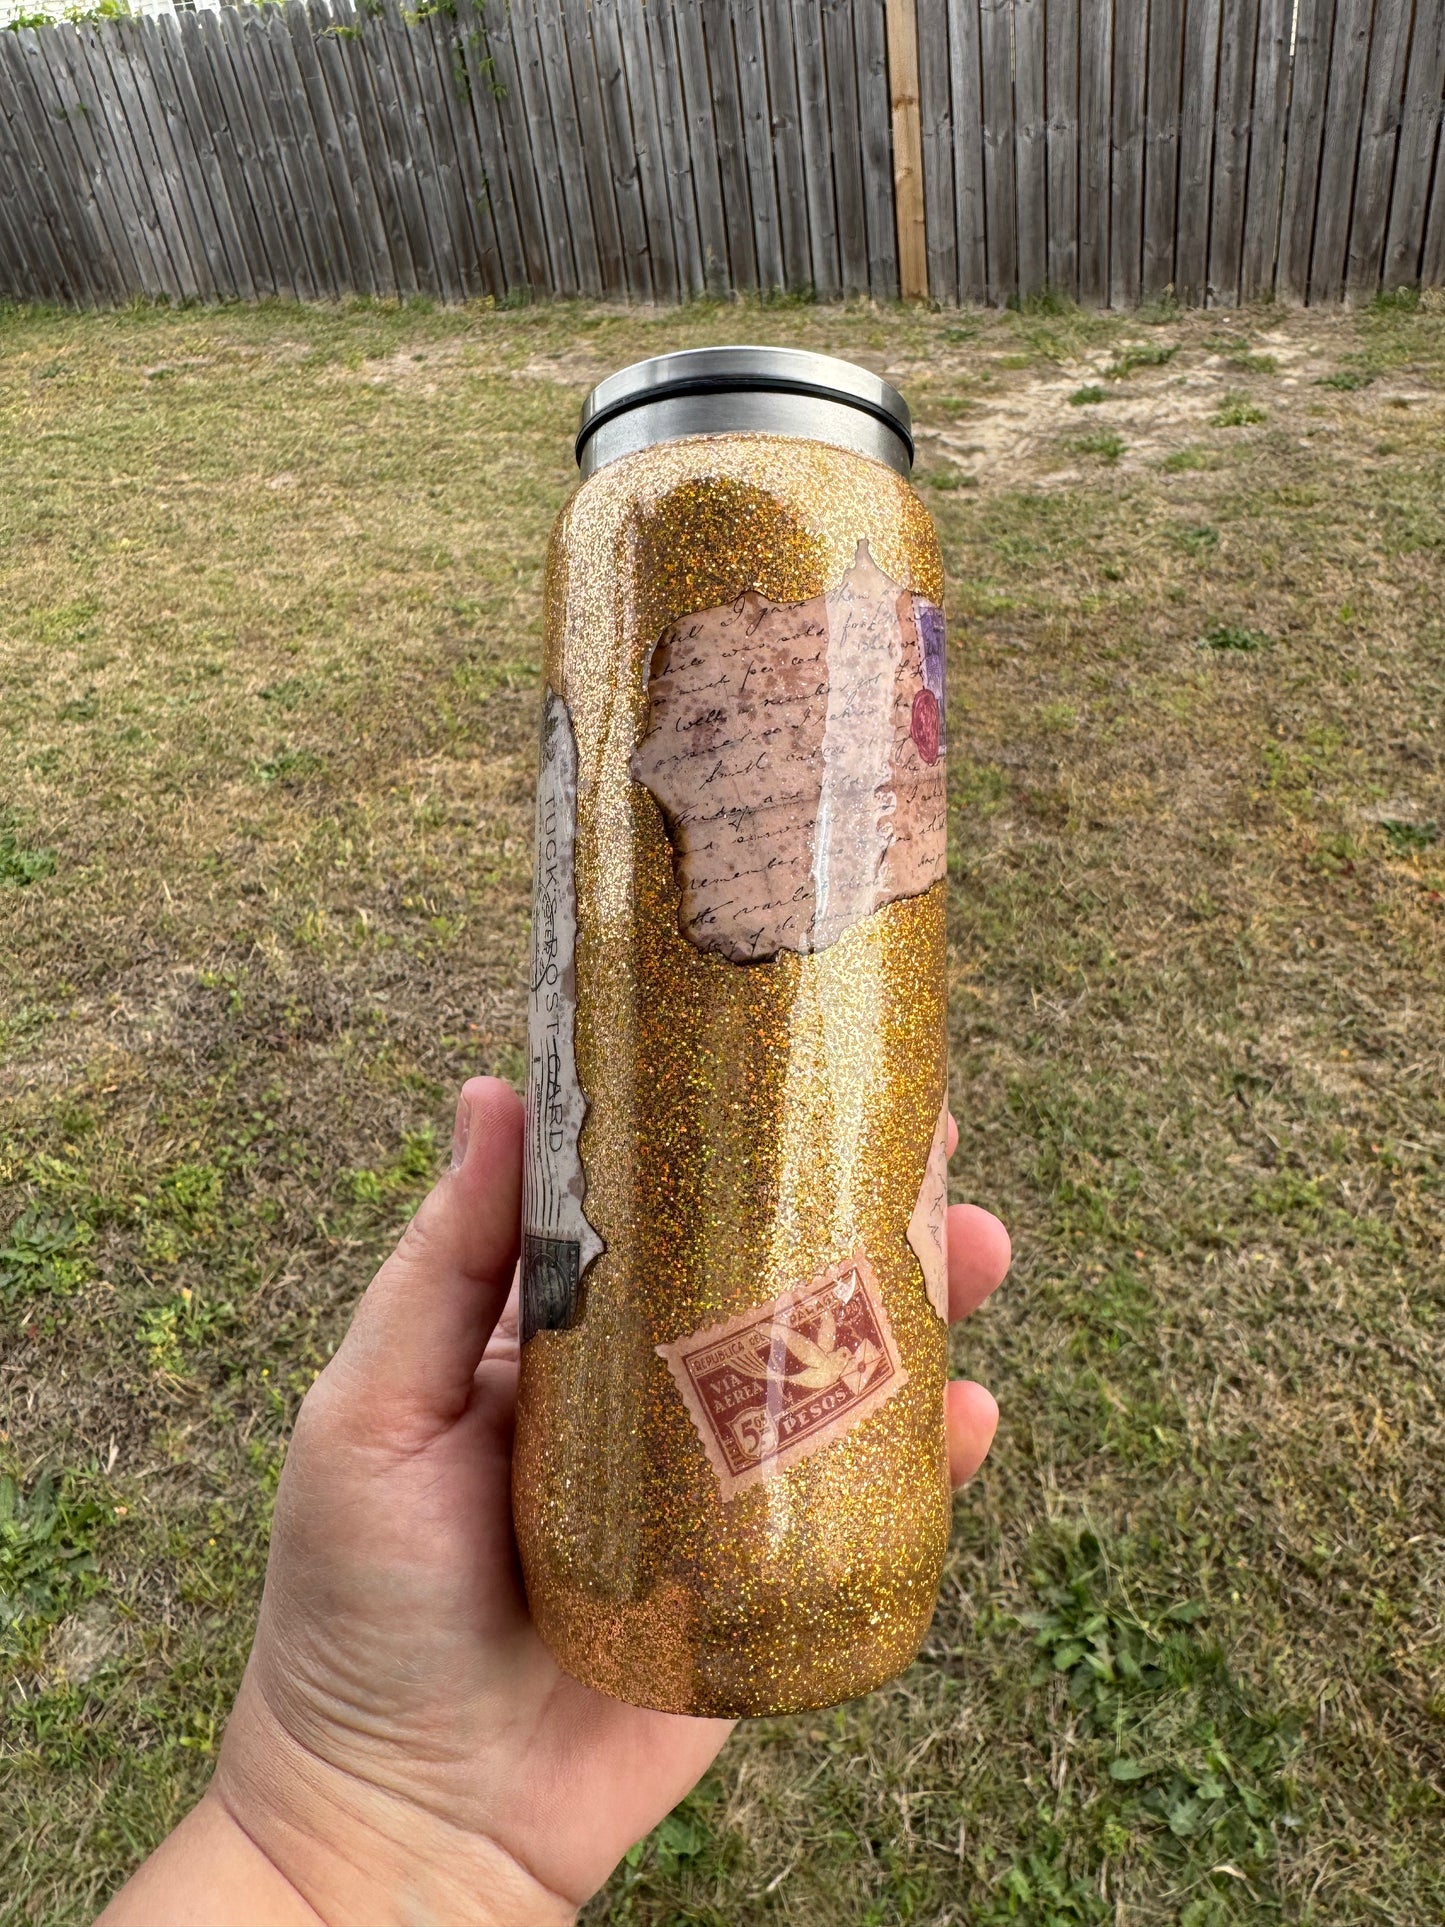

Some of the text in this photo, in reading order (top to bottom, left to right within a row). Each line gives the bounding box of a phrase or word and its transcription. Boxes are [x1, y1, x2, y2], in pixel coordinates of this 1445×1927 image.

[545, 938, 560, 1035] POST
[547, 1050, 564, 1153] CARD
[694, 1341, 746, 1371] REPUBLICA
[709, 1374, 742, 1395] VIA
[713, 1381, 765, 1414] AEREA
[782, 1387, 848, 1436] PESOS
